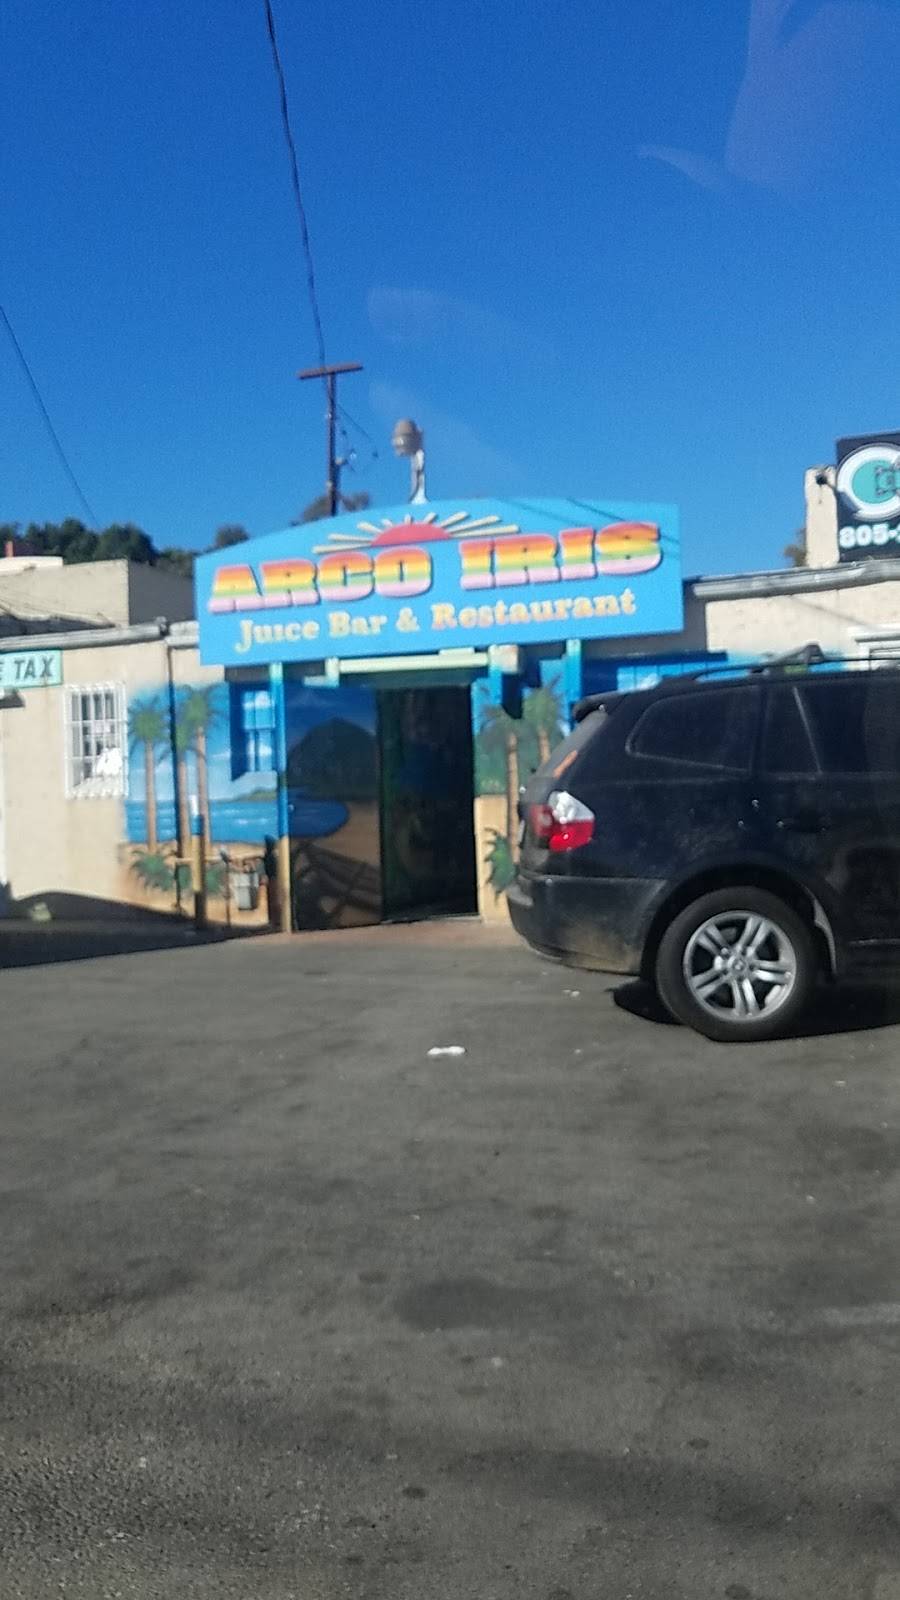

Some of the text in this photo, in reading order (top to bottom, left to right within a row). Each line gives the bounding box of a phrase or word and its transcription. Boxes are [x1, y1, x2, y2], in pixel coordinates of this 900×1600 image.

[208, 521, 662, 614] ARCO IRIS
[235, 587, 637, 652] Juice Bar & Restaurant
[14, 655, 55, 680] TAX
